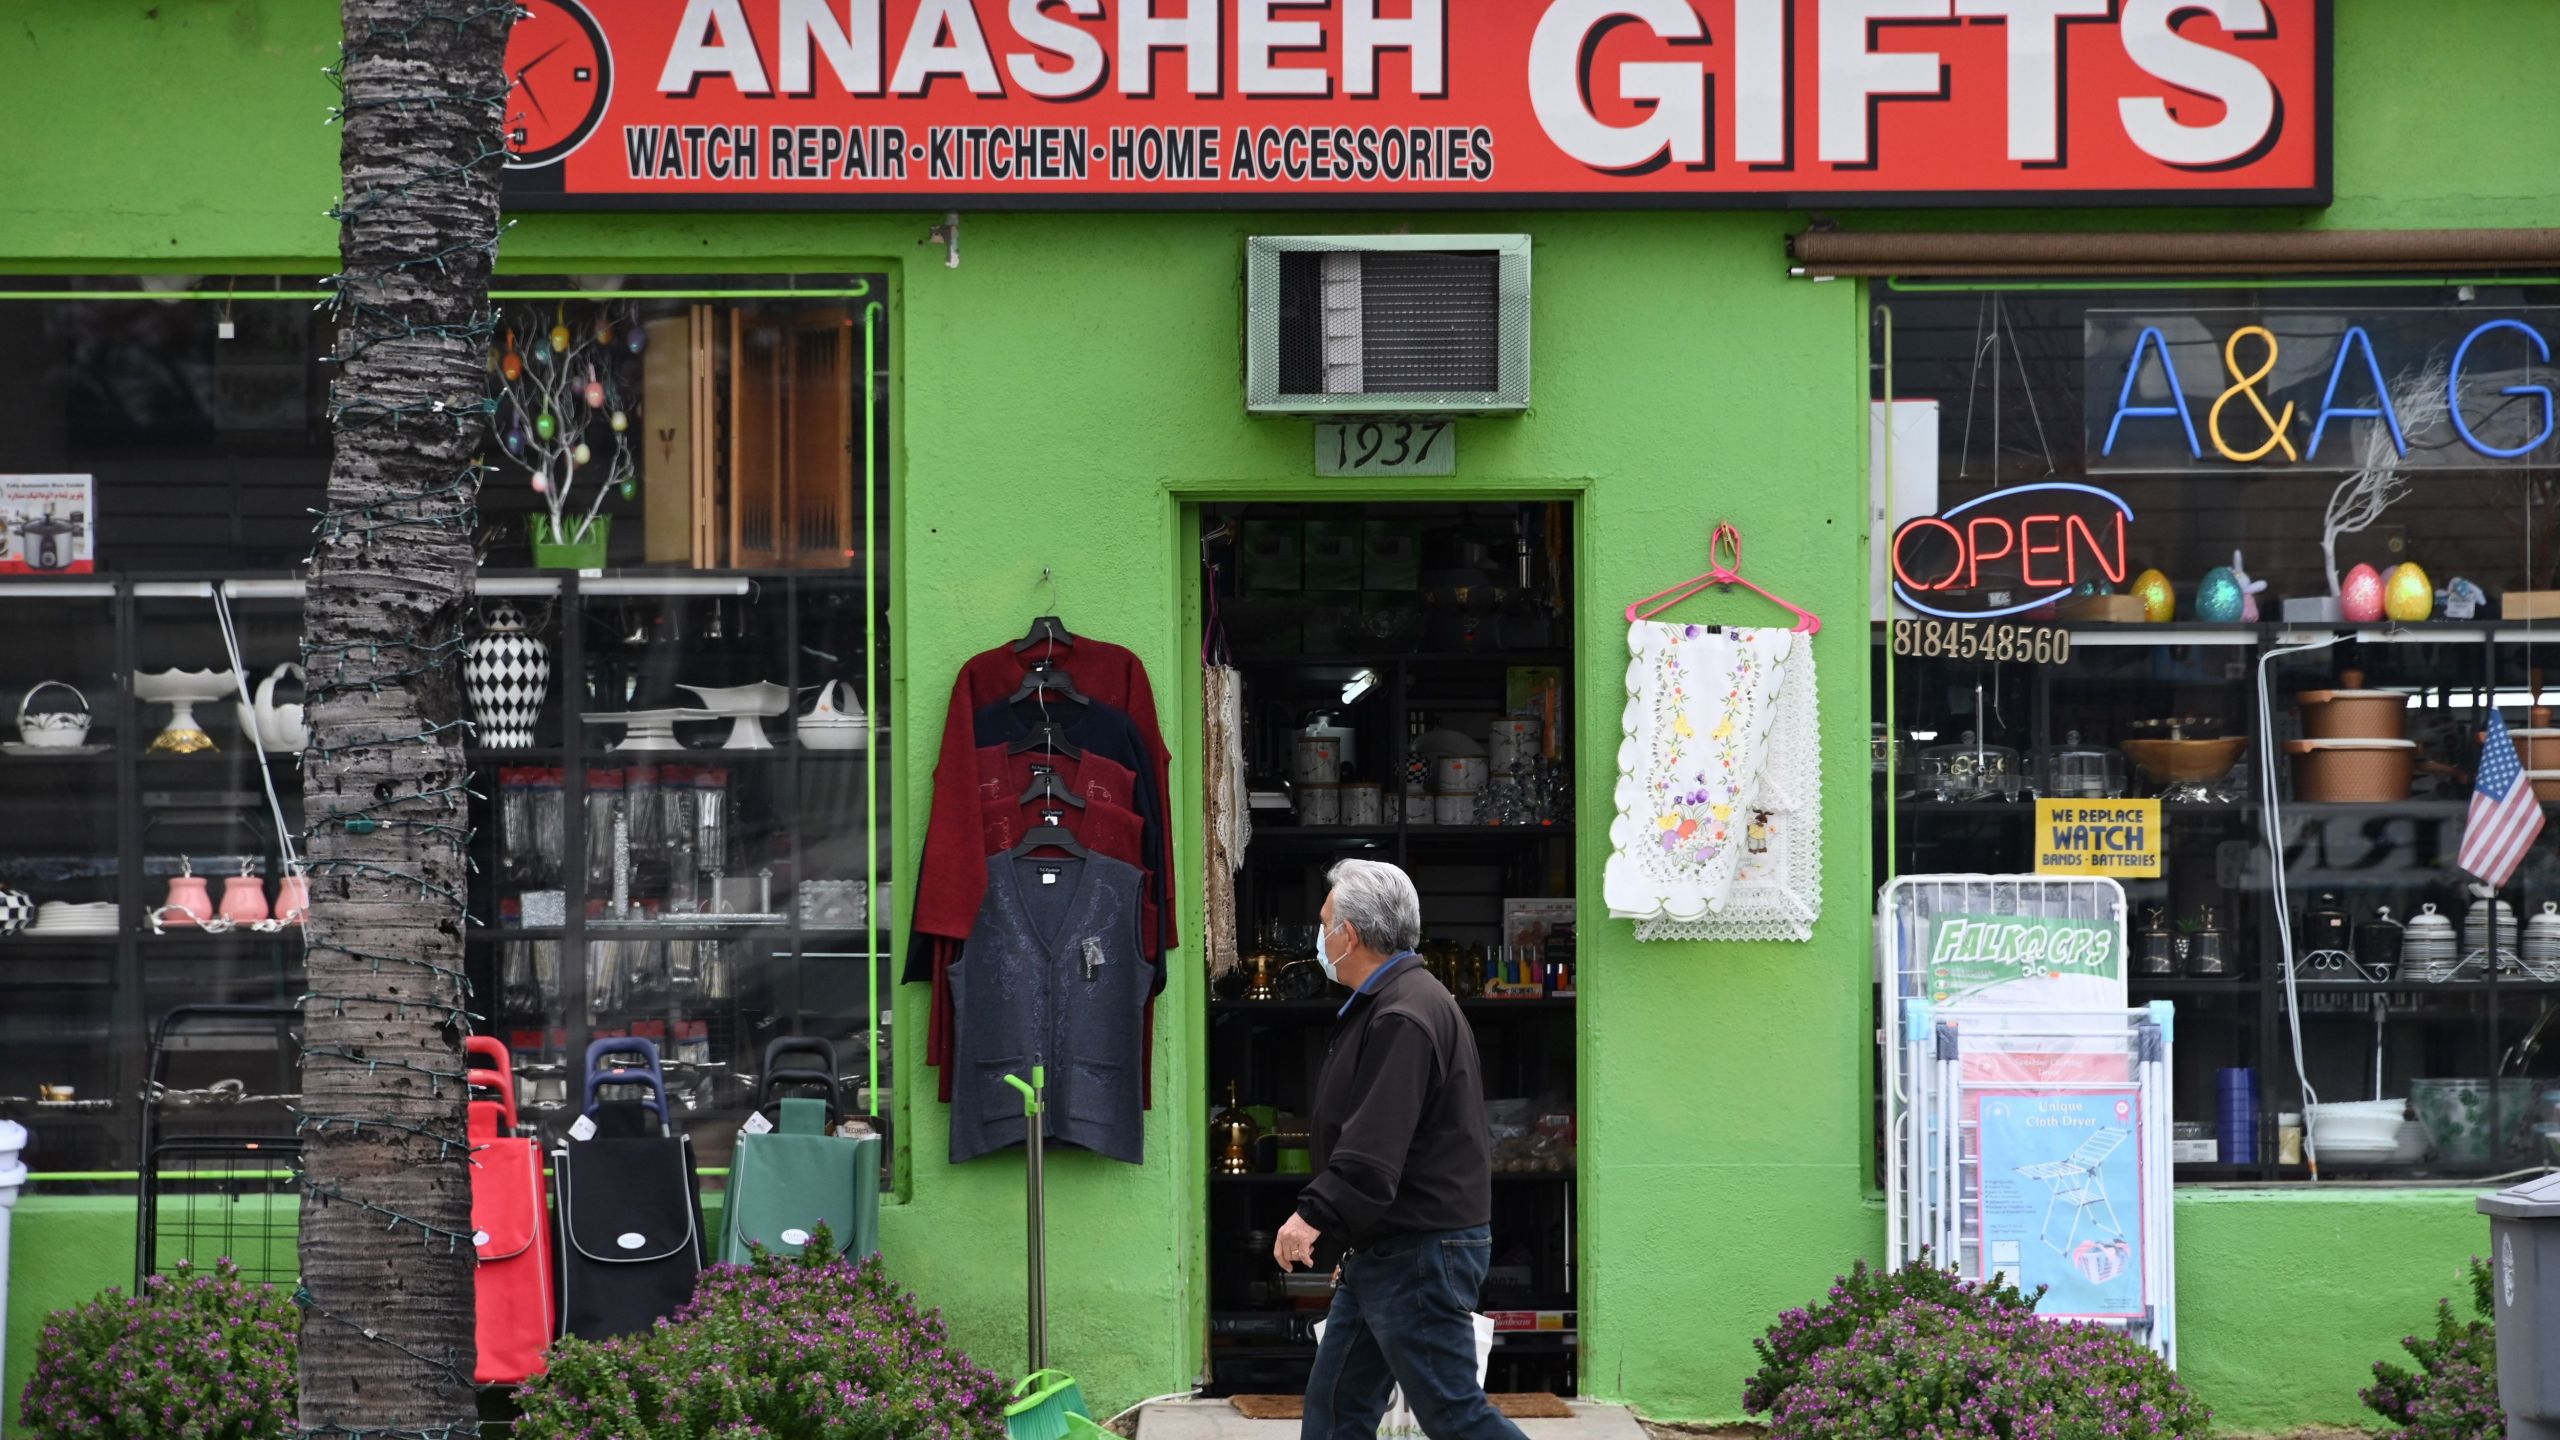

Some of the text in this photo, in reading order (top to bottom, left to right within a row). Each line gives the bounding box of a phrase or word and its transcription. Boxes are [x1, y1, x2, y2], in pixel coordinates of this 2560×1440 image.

[656, 0, 2285, 175] ANASHEH GIFTS
[624, 125, 758, 179] WATCH
[1229, 125, 1494, 181] ACCESSORIES
[1338, 420, 1449, 469] 1937
[1893, 511, 2126, 590] OPEN
[1894, 619, 2070, 665] 8184548560
[2052, 809, 2144, 823] WE REPLACE
[2052, 825, 2144, 851] WATCH
[2042, 854, 2156, 867] BANDS BATTERIES
[2026, 1116, 2097, 1129] Cloth Dryer
[2039, 1102, 2083, 1113] Unique
